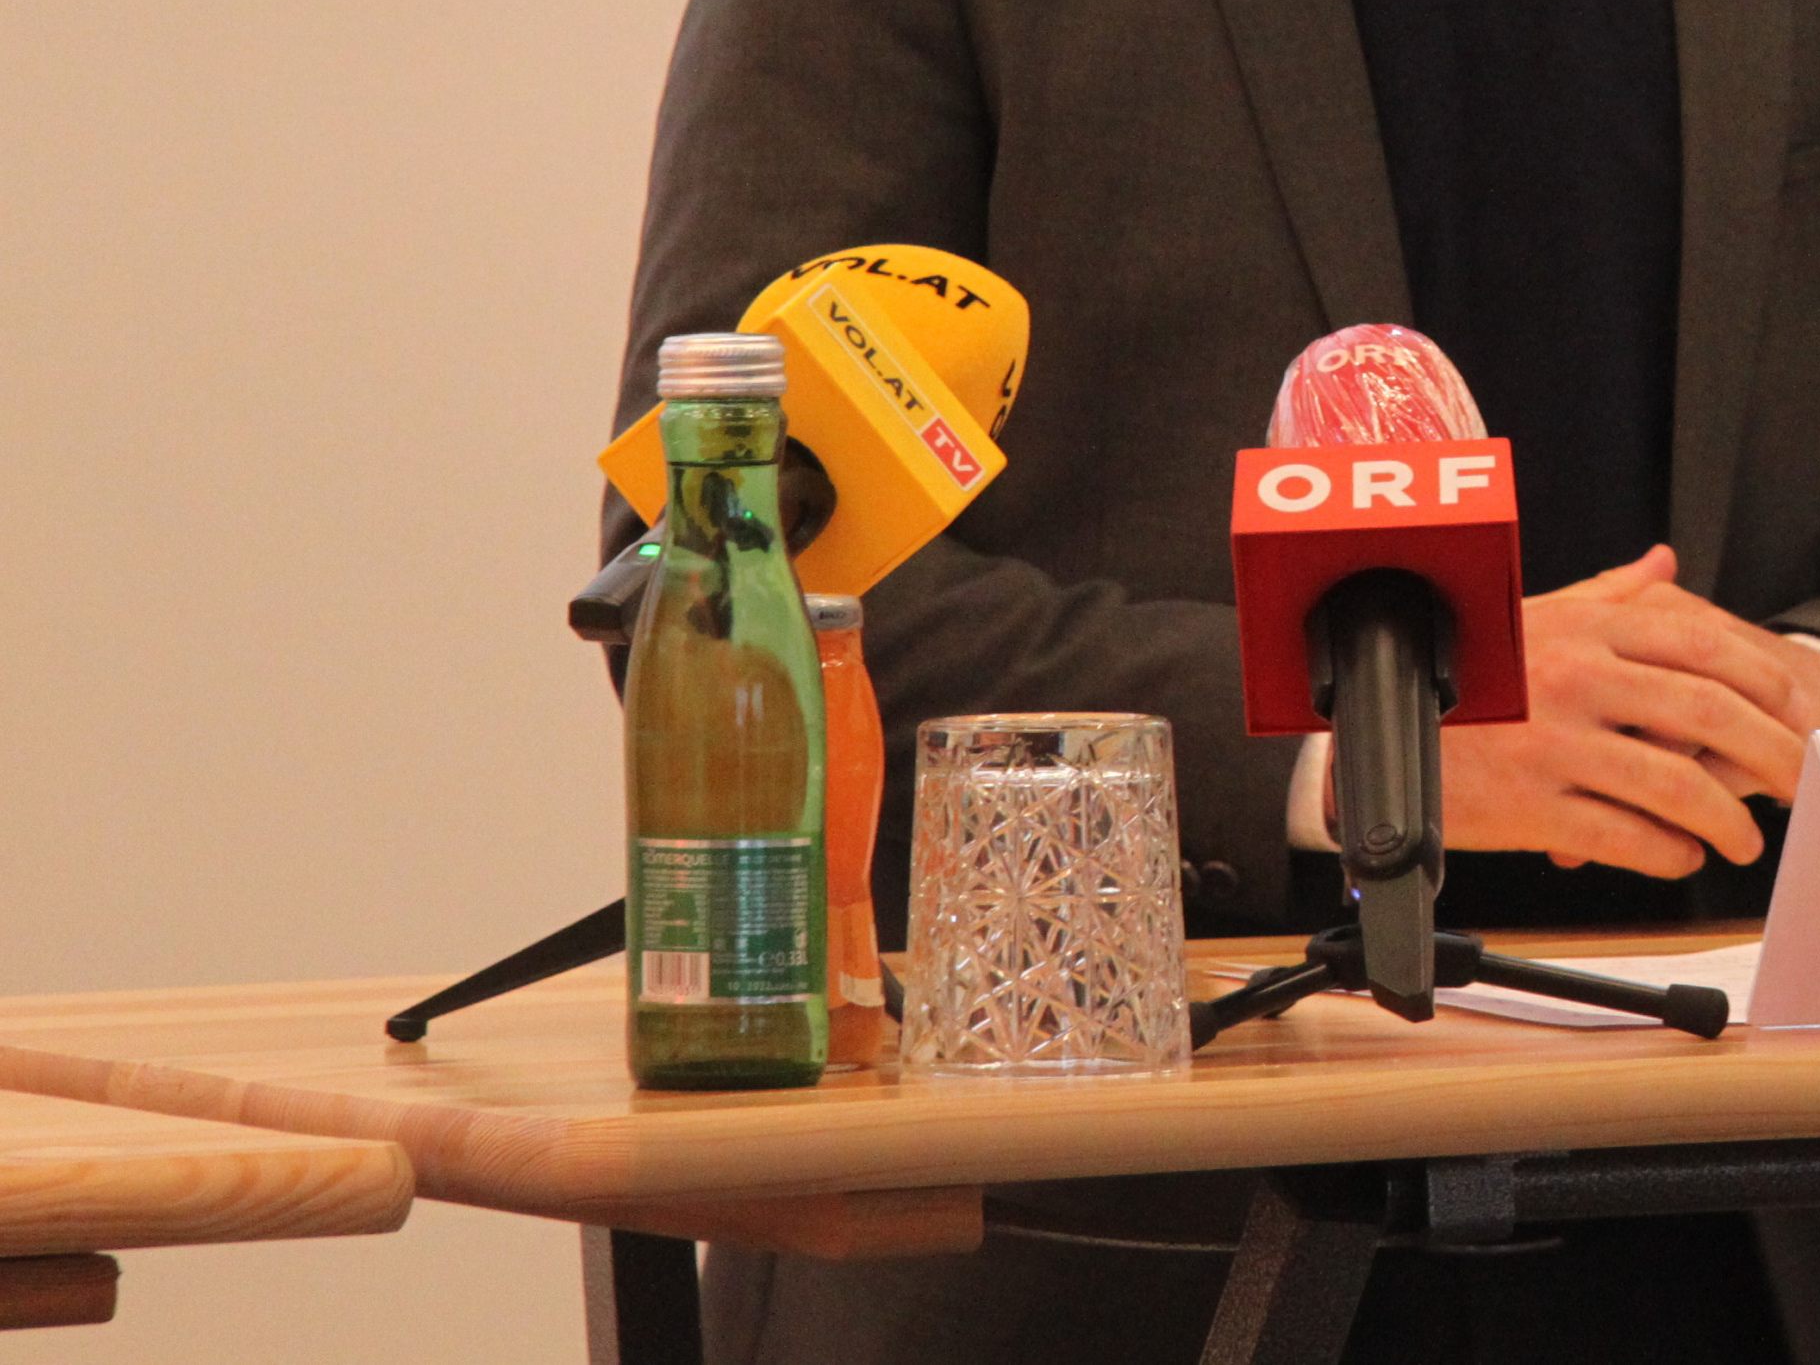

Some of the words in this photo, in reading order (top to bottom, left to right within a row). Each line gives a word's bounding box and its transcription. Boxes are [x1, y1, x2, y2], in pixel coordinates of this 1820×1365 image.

[828, 301, 925, 411] VOL.AT
[933, 425, 975, 473] TV
[1316, 344, 1421, 373] ORF
[1257, 455, 1496, 513] ORF
